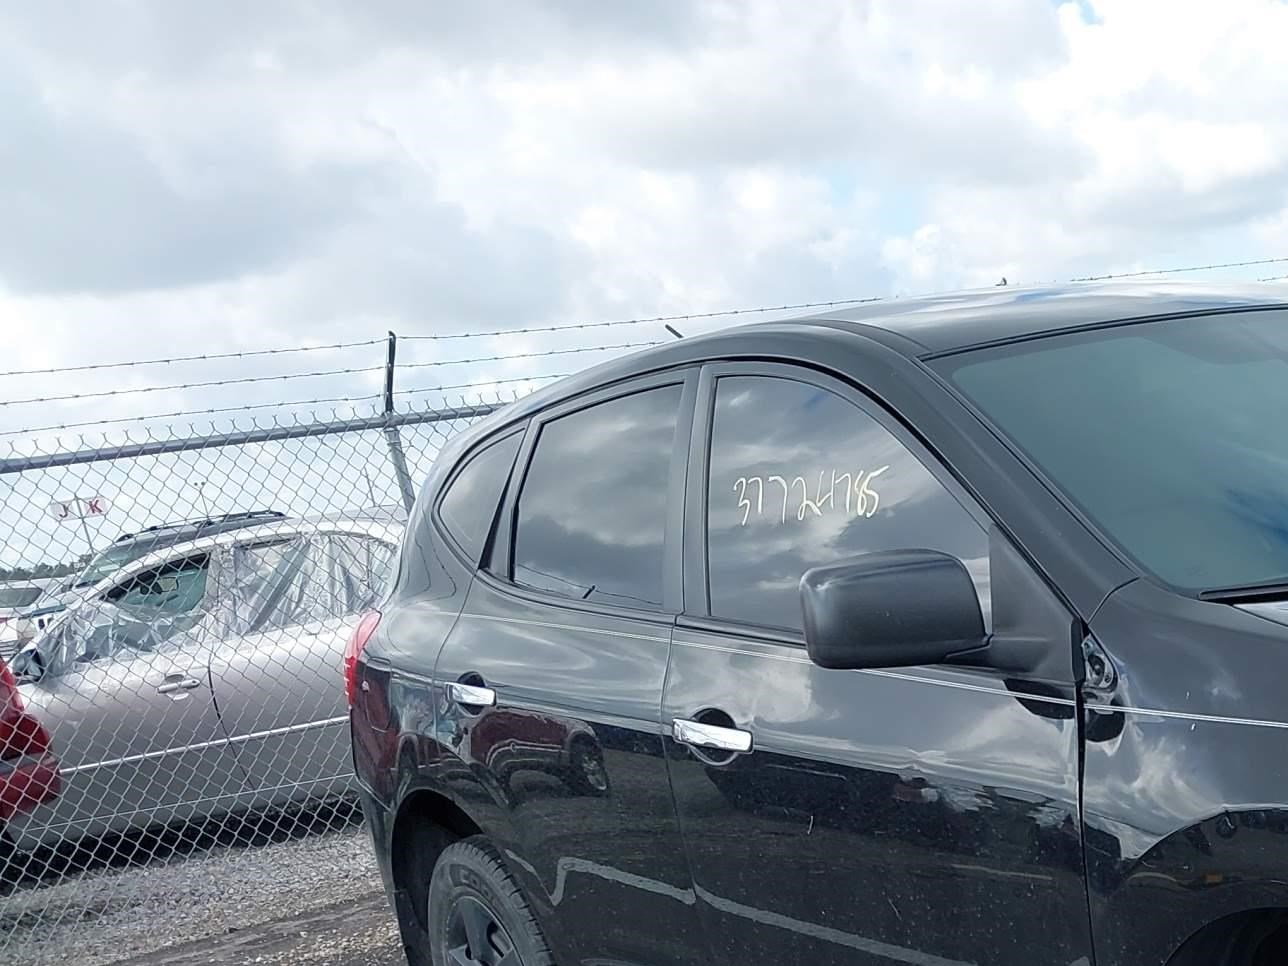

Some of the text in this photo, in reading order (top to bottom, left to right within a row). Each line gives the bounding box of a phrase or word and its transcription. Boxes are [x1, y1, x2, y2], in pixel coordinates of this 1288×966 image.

[733, 465, 890, 526] 37724785
[59, 504, 68, 518] J
[89, 499, 103, 514] K
